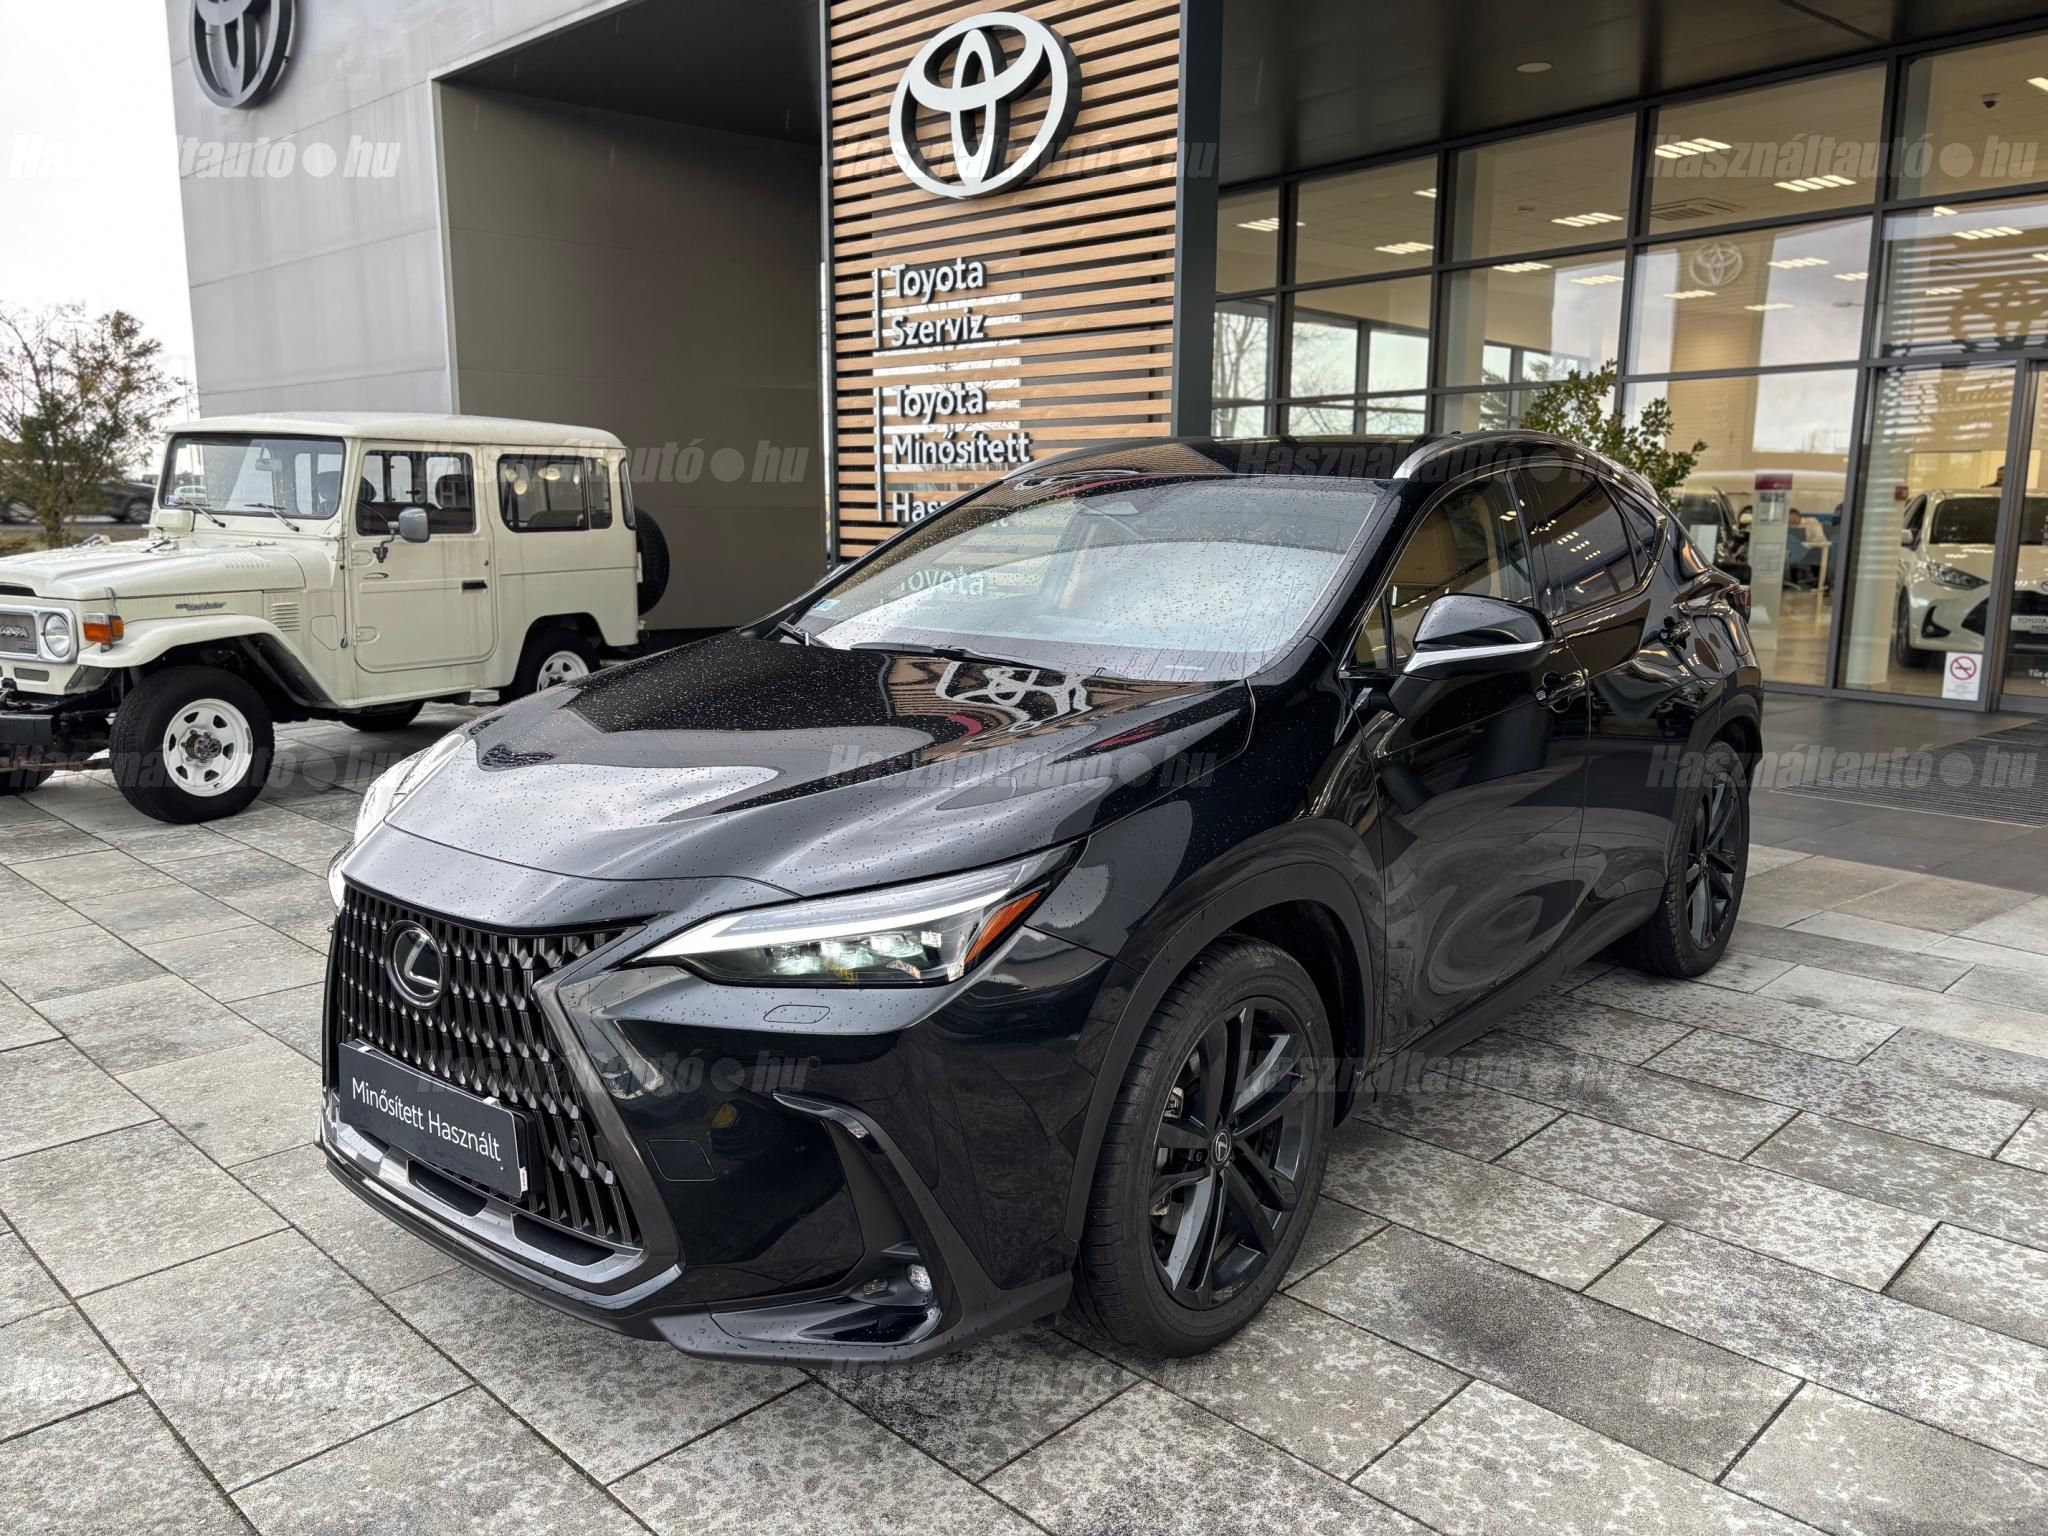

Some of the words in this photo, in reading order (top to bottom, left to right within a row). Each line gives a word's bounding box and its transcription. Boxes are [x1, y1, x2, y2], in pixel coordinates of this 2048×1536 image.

[890, 258, 984, 304] Toyota
[891, 307, 984, 346] Szerviz
[893, 383, 984, 424] Toyota
[892, 430, 1030, 464] Minősített
[352, 1077, 425, 1130] Minősített
[428, 1110, 502, 1162] Használt
